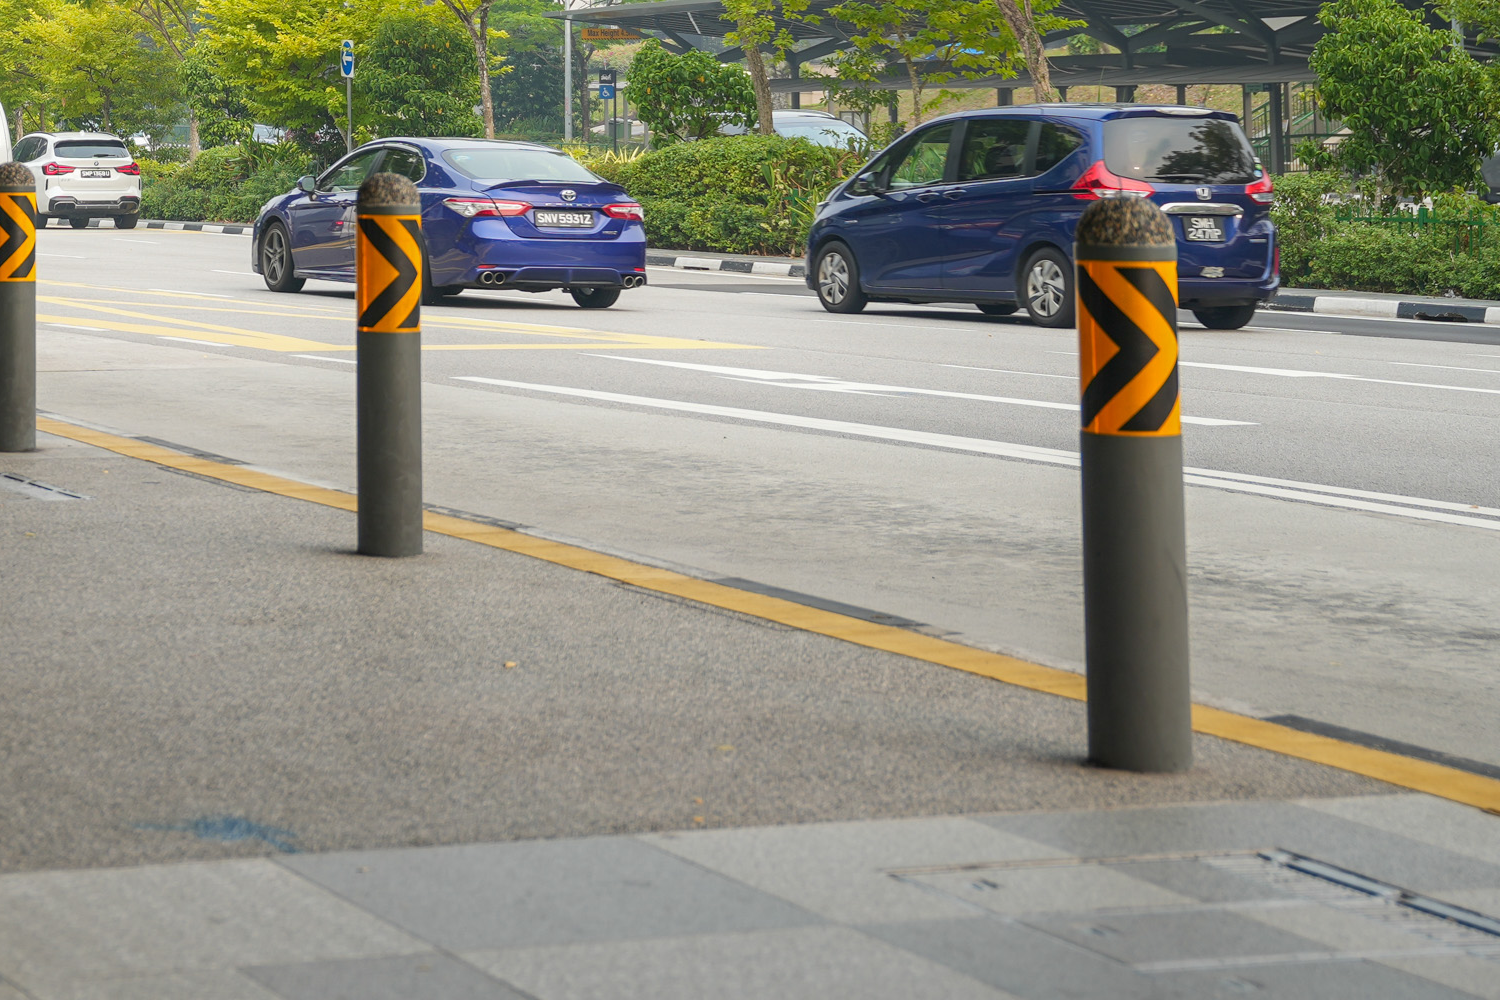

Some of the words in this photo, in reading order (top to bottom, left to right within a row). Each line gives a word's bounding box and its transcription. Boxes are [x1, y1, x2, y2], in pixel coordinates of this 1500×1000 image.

[601, 30, 619, 38] Height
[537, 213, 592, 224] SNV5931Z
[1190, 217, 1215, 229] SMH
